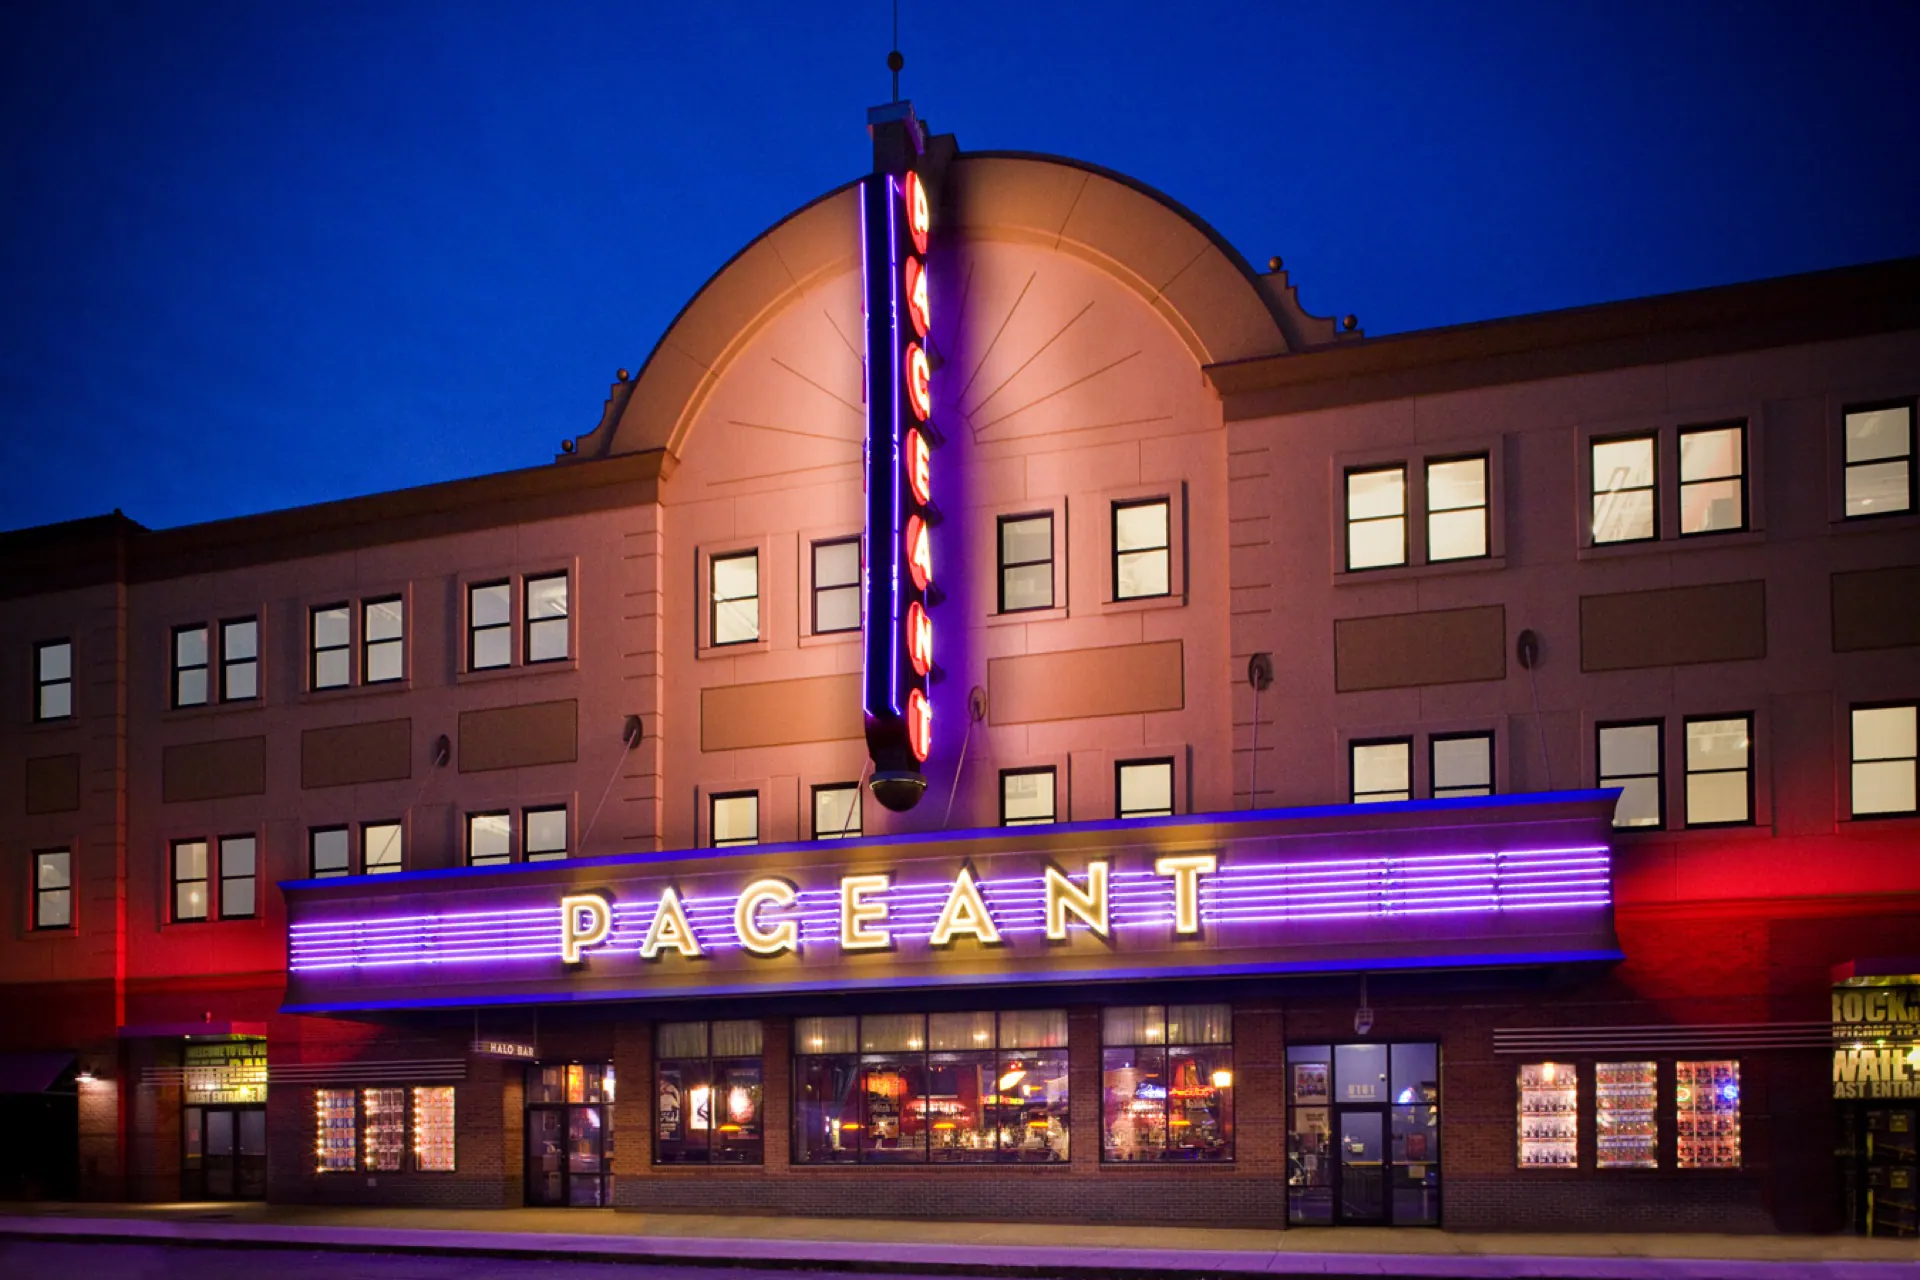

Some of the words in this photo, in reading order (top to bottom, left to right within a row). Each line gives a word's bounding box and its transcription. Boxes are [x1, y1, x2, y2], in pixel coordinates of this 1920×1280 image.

[560, 855, 1217, 965] PAGEANT
[490, 1042, 514, 1054] HALO
[517, 1045, 534, 1057] BAR
[1833, 1081, 1867, 1099] AST
